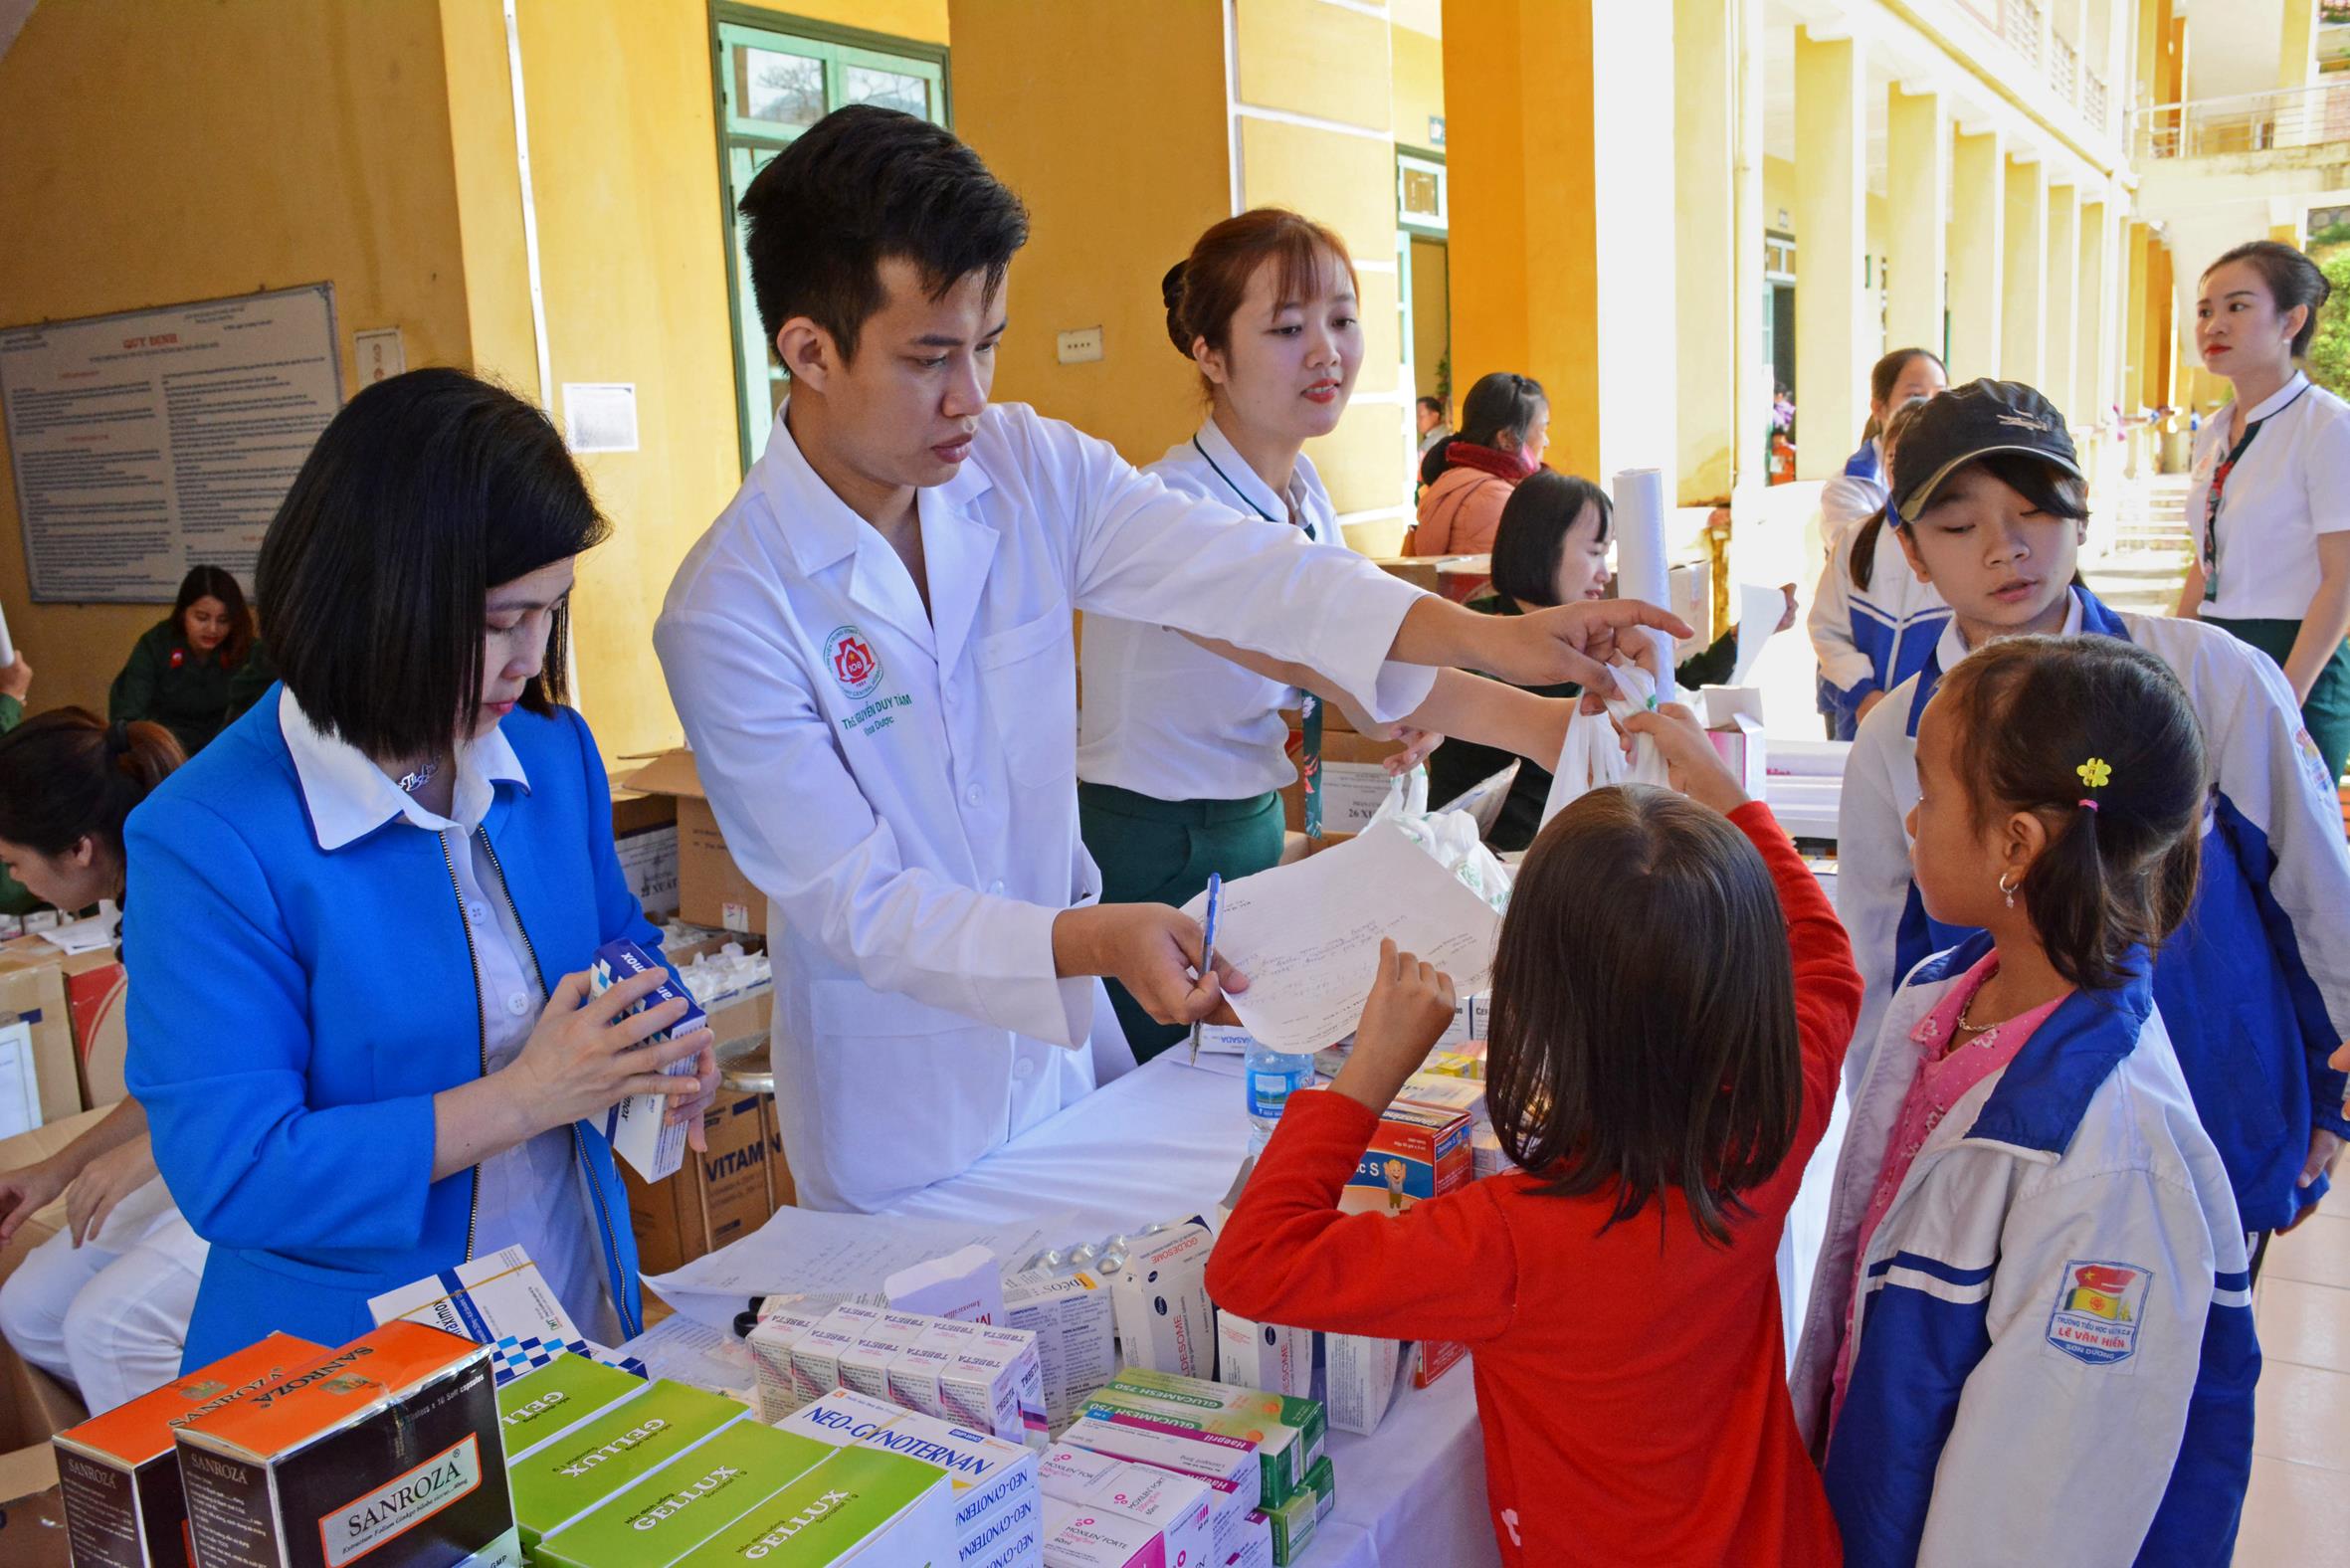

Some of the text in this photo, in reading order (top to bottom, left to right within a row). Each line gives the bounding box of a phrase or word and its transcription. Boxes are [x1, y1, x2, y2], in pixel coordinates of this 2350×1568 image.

[849, 662, 863, 673] 108
[876, 697, 893, 713] DUY
[1369, 1162, 1380, 1177] S
[1151, 1237, 1199, 1265] GOLDESOME
[2058, 1326, 2072, 1338] LÊ
[2074, 1329, 2099, 1344] VĂN
[2085, 1346, 2115, 1360] DƯƠNG
[250, 1346, 375, 1404] SANROZA
[460, 1373, 486, 1394] capsules
[1114, 1383, 1220, 1409] GLUCAMESH 750
[1116, 1409, 1194, 1429] GLUCAMESH
[560, 1418, 666, 1477] GELLUX
[802, 1405, 995, 1476] NEO-GYNOTERNAN
[1204, 1434, 1247, 1450] Haepril
[68, 1457, 116, 1490] SANROZA
[190, 1453, 249, 1485] SANROZA
[348, 1460, 461, 1538] SANROZA
[632, 1465, 738, 1531] GELLUX
[744, 1489, 850, 1560] GELLUX
[958, 1499, 1033, 1563] NEO-GYNOTERNA
[1066, 1525, 1128, 1550] MOXILEN FORTE
[1053, 1536, 1074, 1547] 60ml
